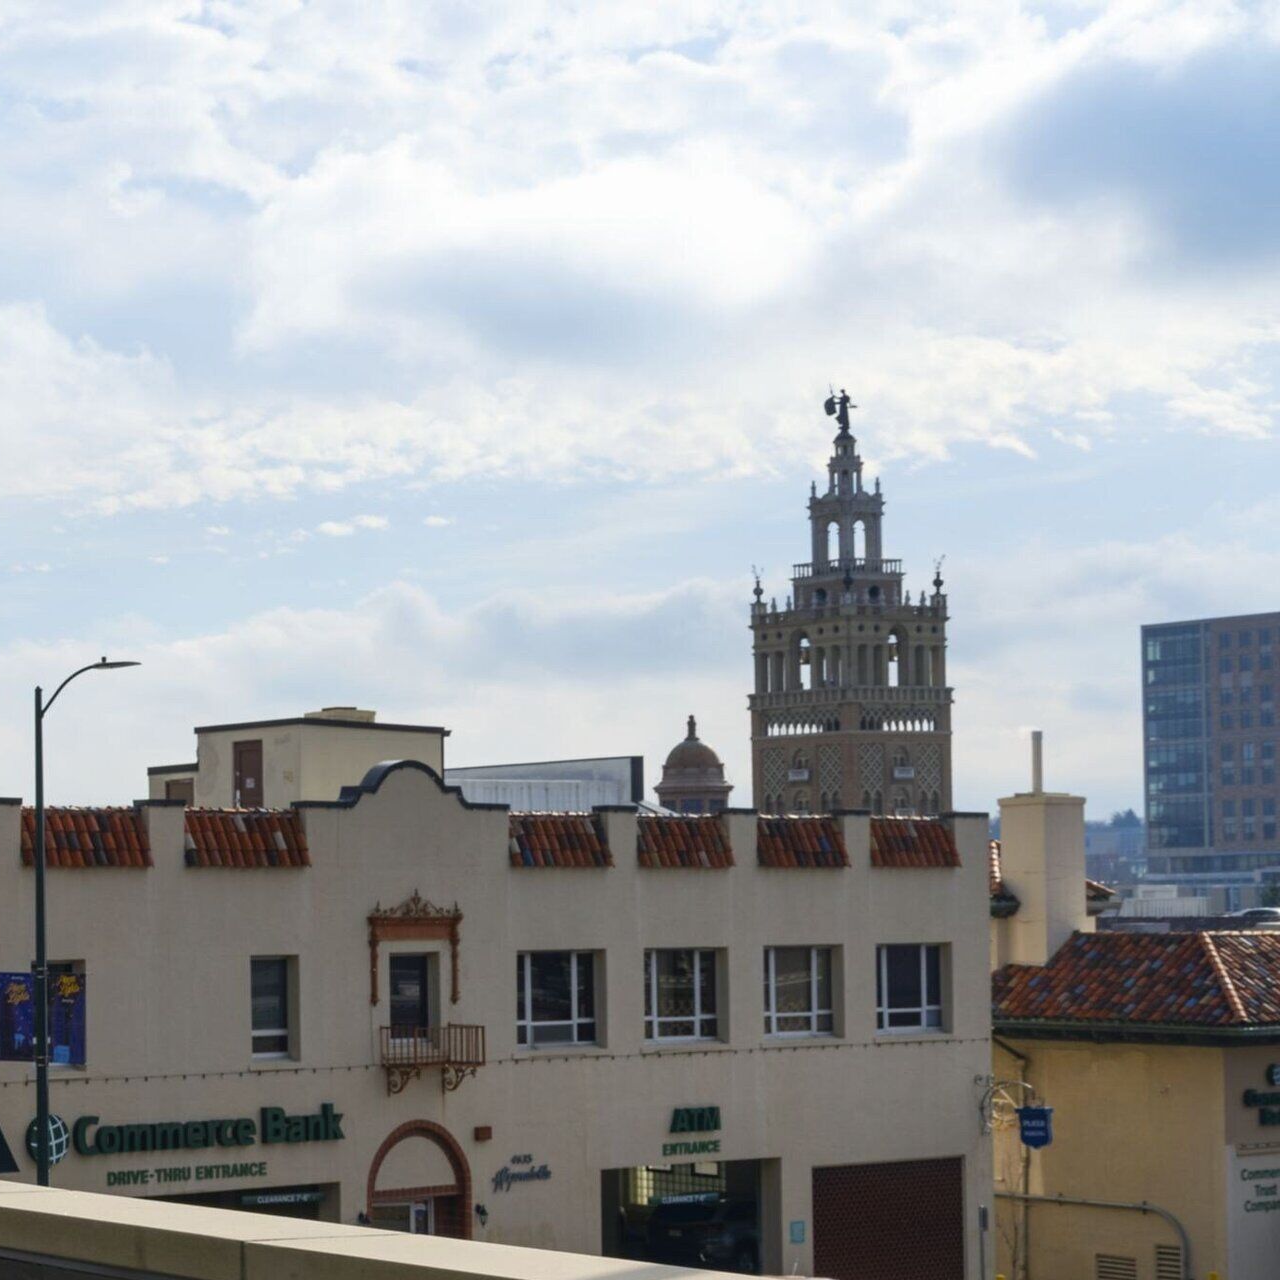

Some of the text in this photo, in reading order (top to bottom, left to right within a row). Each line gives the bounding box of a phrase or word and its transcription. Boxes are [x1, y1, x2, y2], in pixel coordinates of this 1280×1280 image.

[72, 1102, 346, 1157] Commerce Bank
[669, 1106, 722, 1134] ATM
[662, 1140, 721, 1157] ENTRANCE
[106, 1161, 268, 1187] DRIVE-THRU ENTRANCE
[1254, 1183, 1278, 1197] Trust
